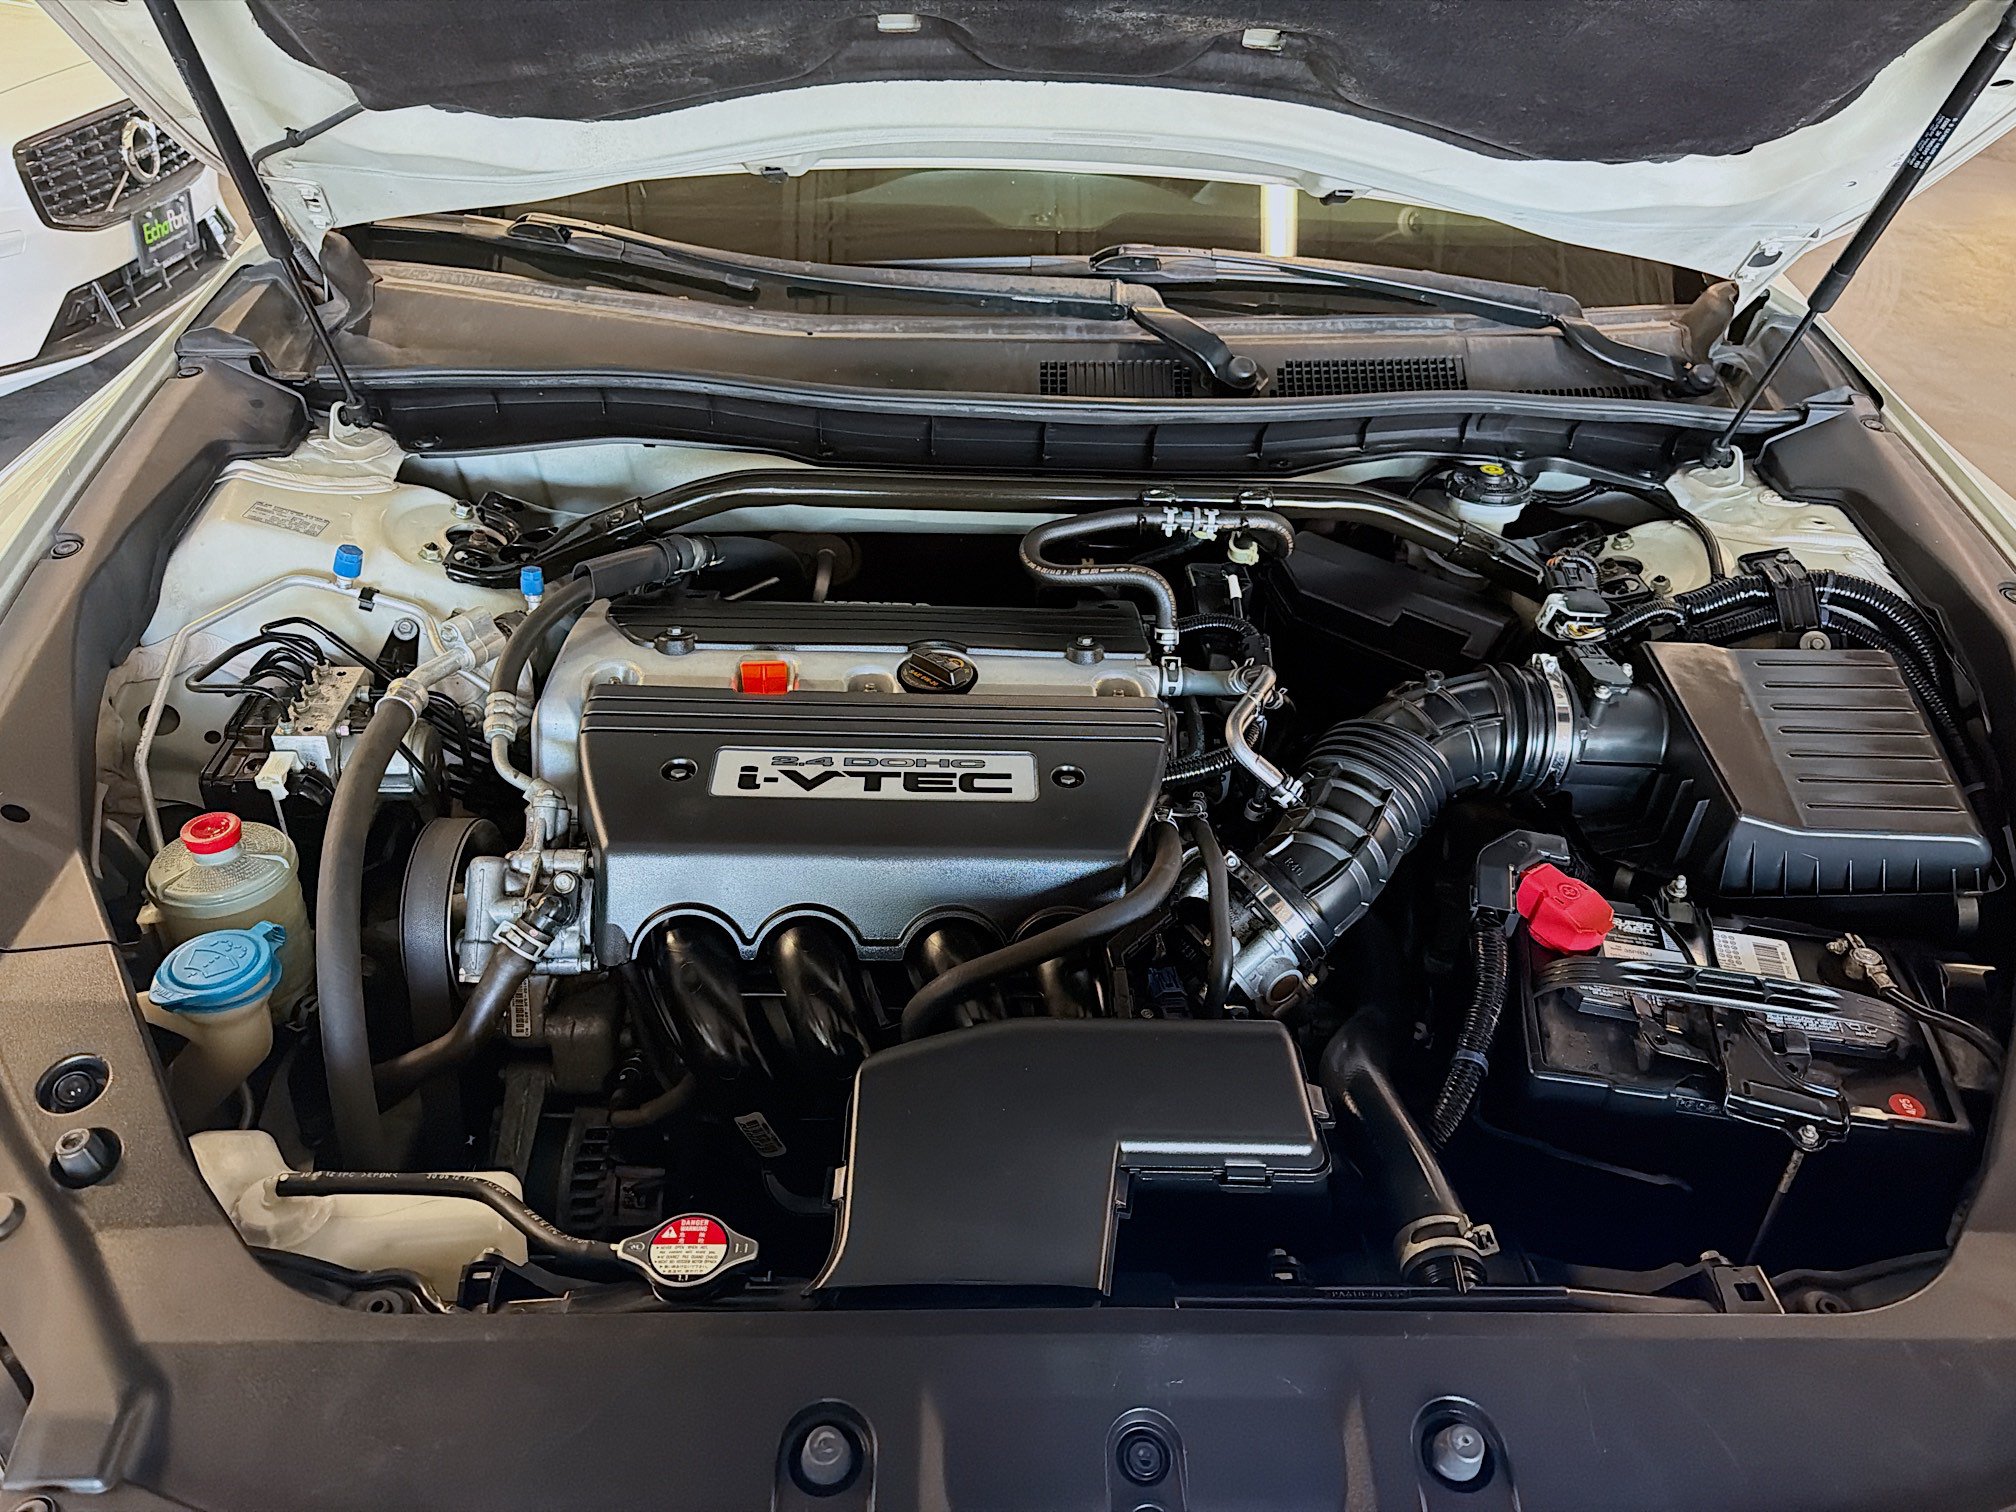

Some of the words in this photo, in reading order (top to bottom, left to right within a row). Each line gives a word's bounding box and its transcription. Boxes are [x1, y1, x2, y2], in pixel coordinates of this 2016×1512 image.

[143, 206, 189, 245] EchoPark
[771, 755, 834, 768] 2.4
[844, 757, 986, 769] DOHC
[737, 766, 1013, 793] i-VTEC
[152, 986, 175, 1001] PULL
[735, 1243, 748, 1253] 1.1
